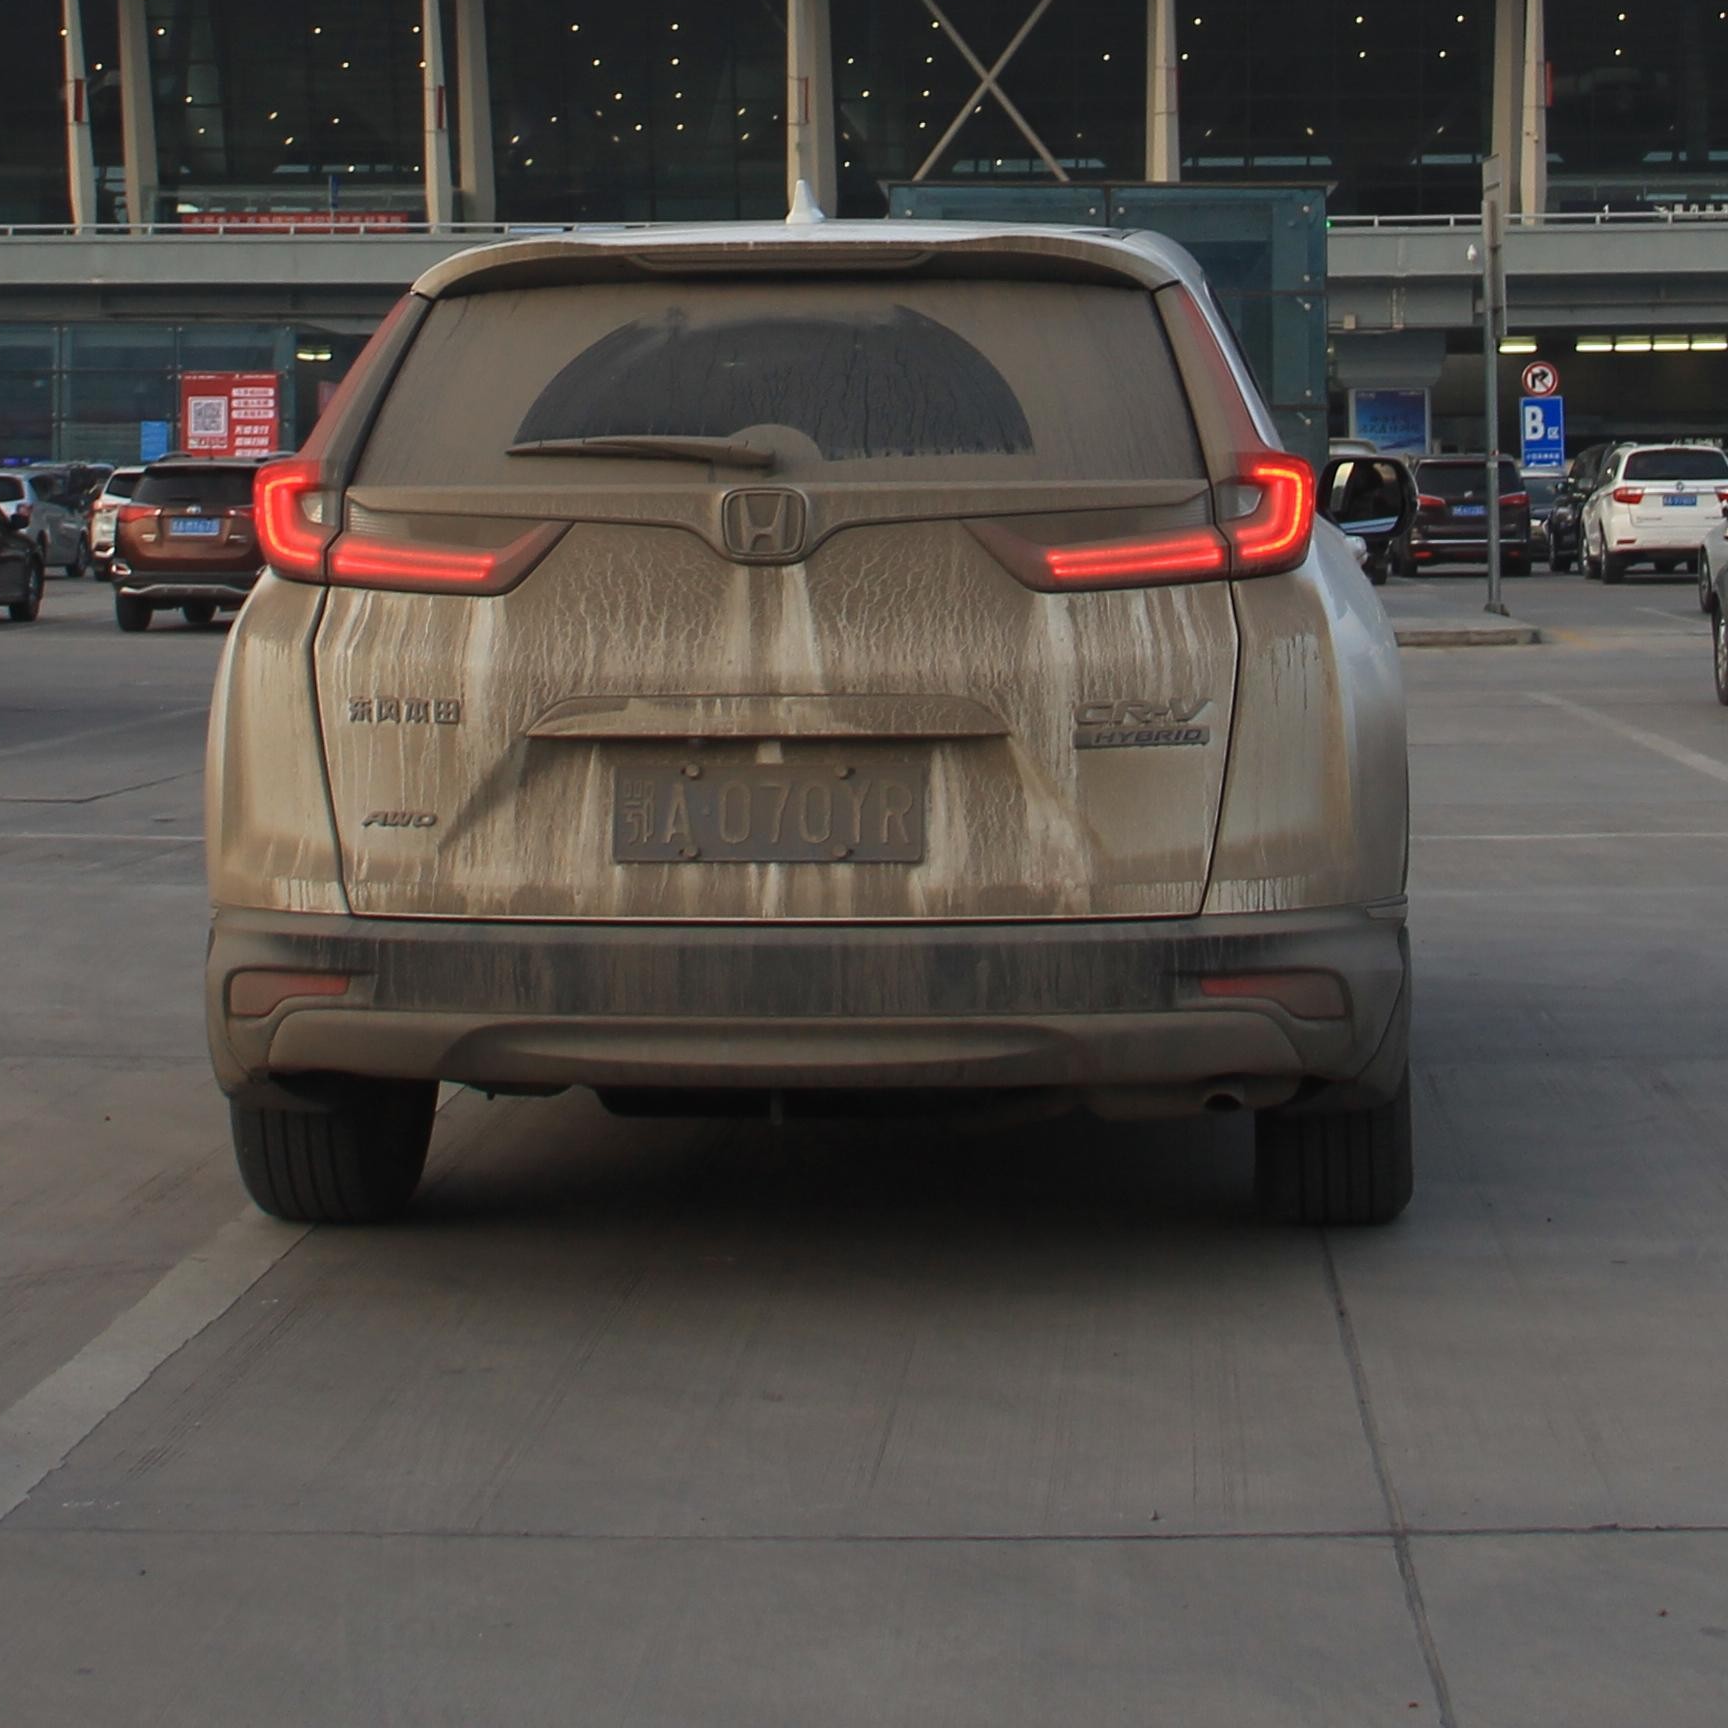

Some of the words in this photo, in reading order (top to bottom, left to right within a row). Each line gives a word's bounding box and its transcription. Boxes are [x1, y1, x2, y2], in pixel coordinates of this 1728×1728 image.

[349, 696, 460, 724] 东风本田
[1074, 697, 1213, 725] CR-V
[1094, 728, 1203, 745] HYBRID
[362, 810, 438, 828] AWD
